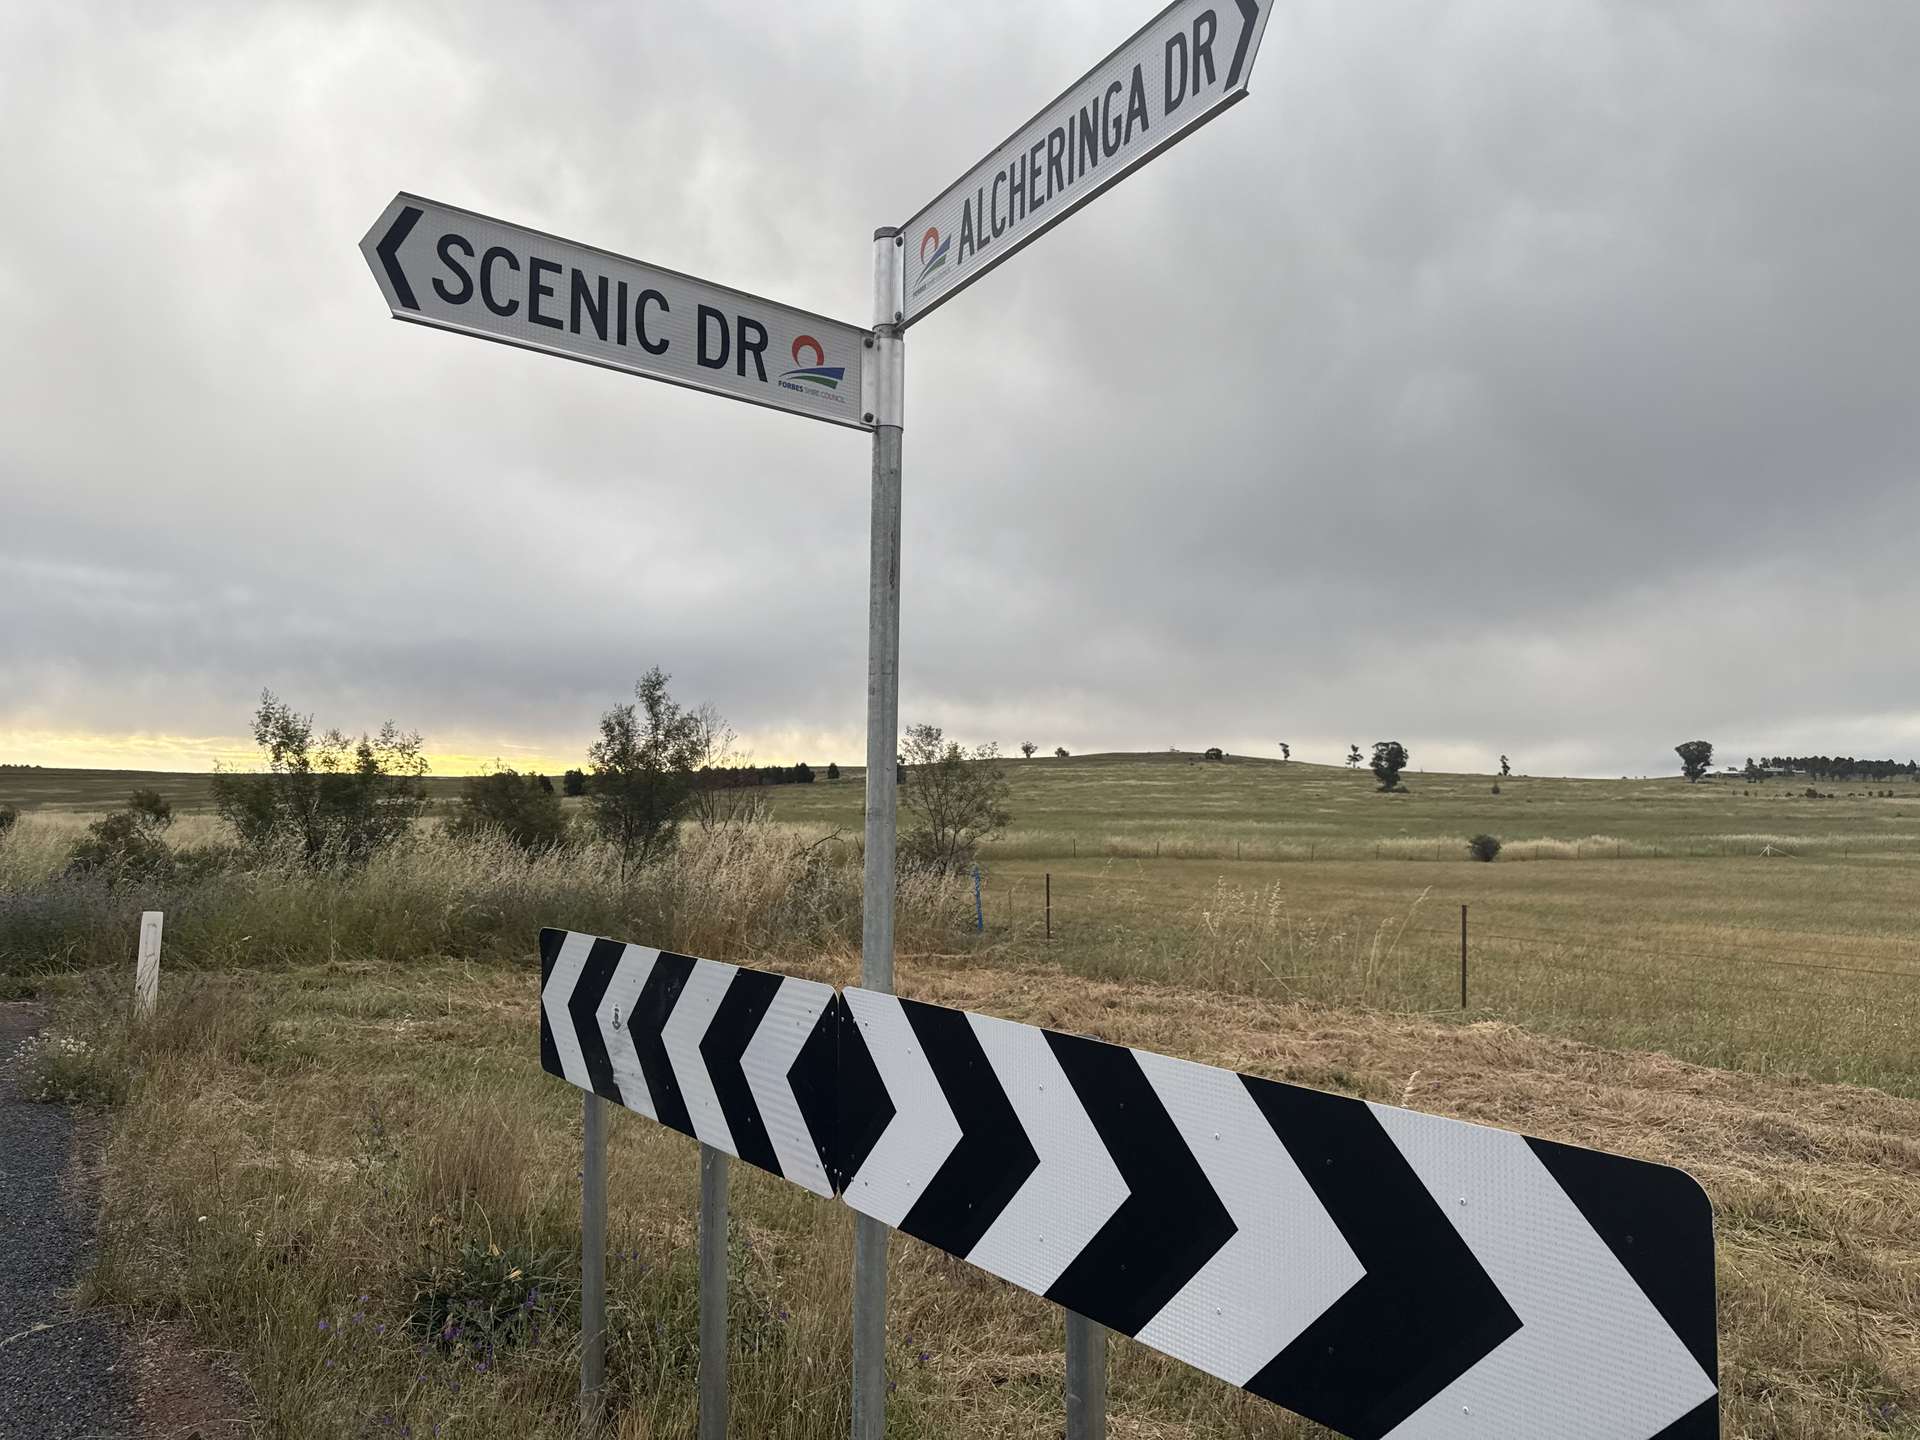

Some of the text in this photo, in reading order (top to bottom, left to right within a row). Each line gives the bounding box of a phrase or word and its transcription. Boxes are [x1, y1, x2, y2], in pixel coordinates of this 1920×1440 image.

[957, 9, 1218, 265] ALCHERINGA DR
[432, 233, 768, 383] SCENIC DR
[778, 380, 804, 393] FORBES
